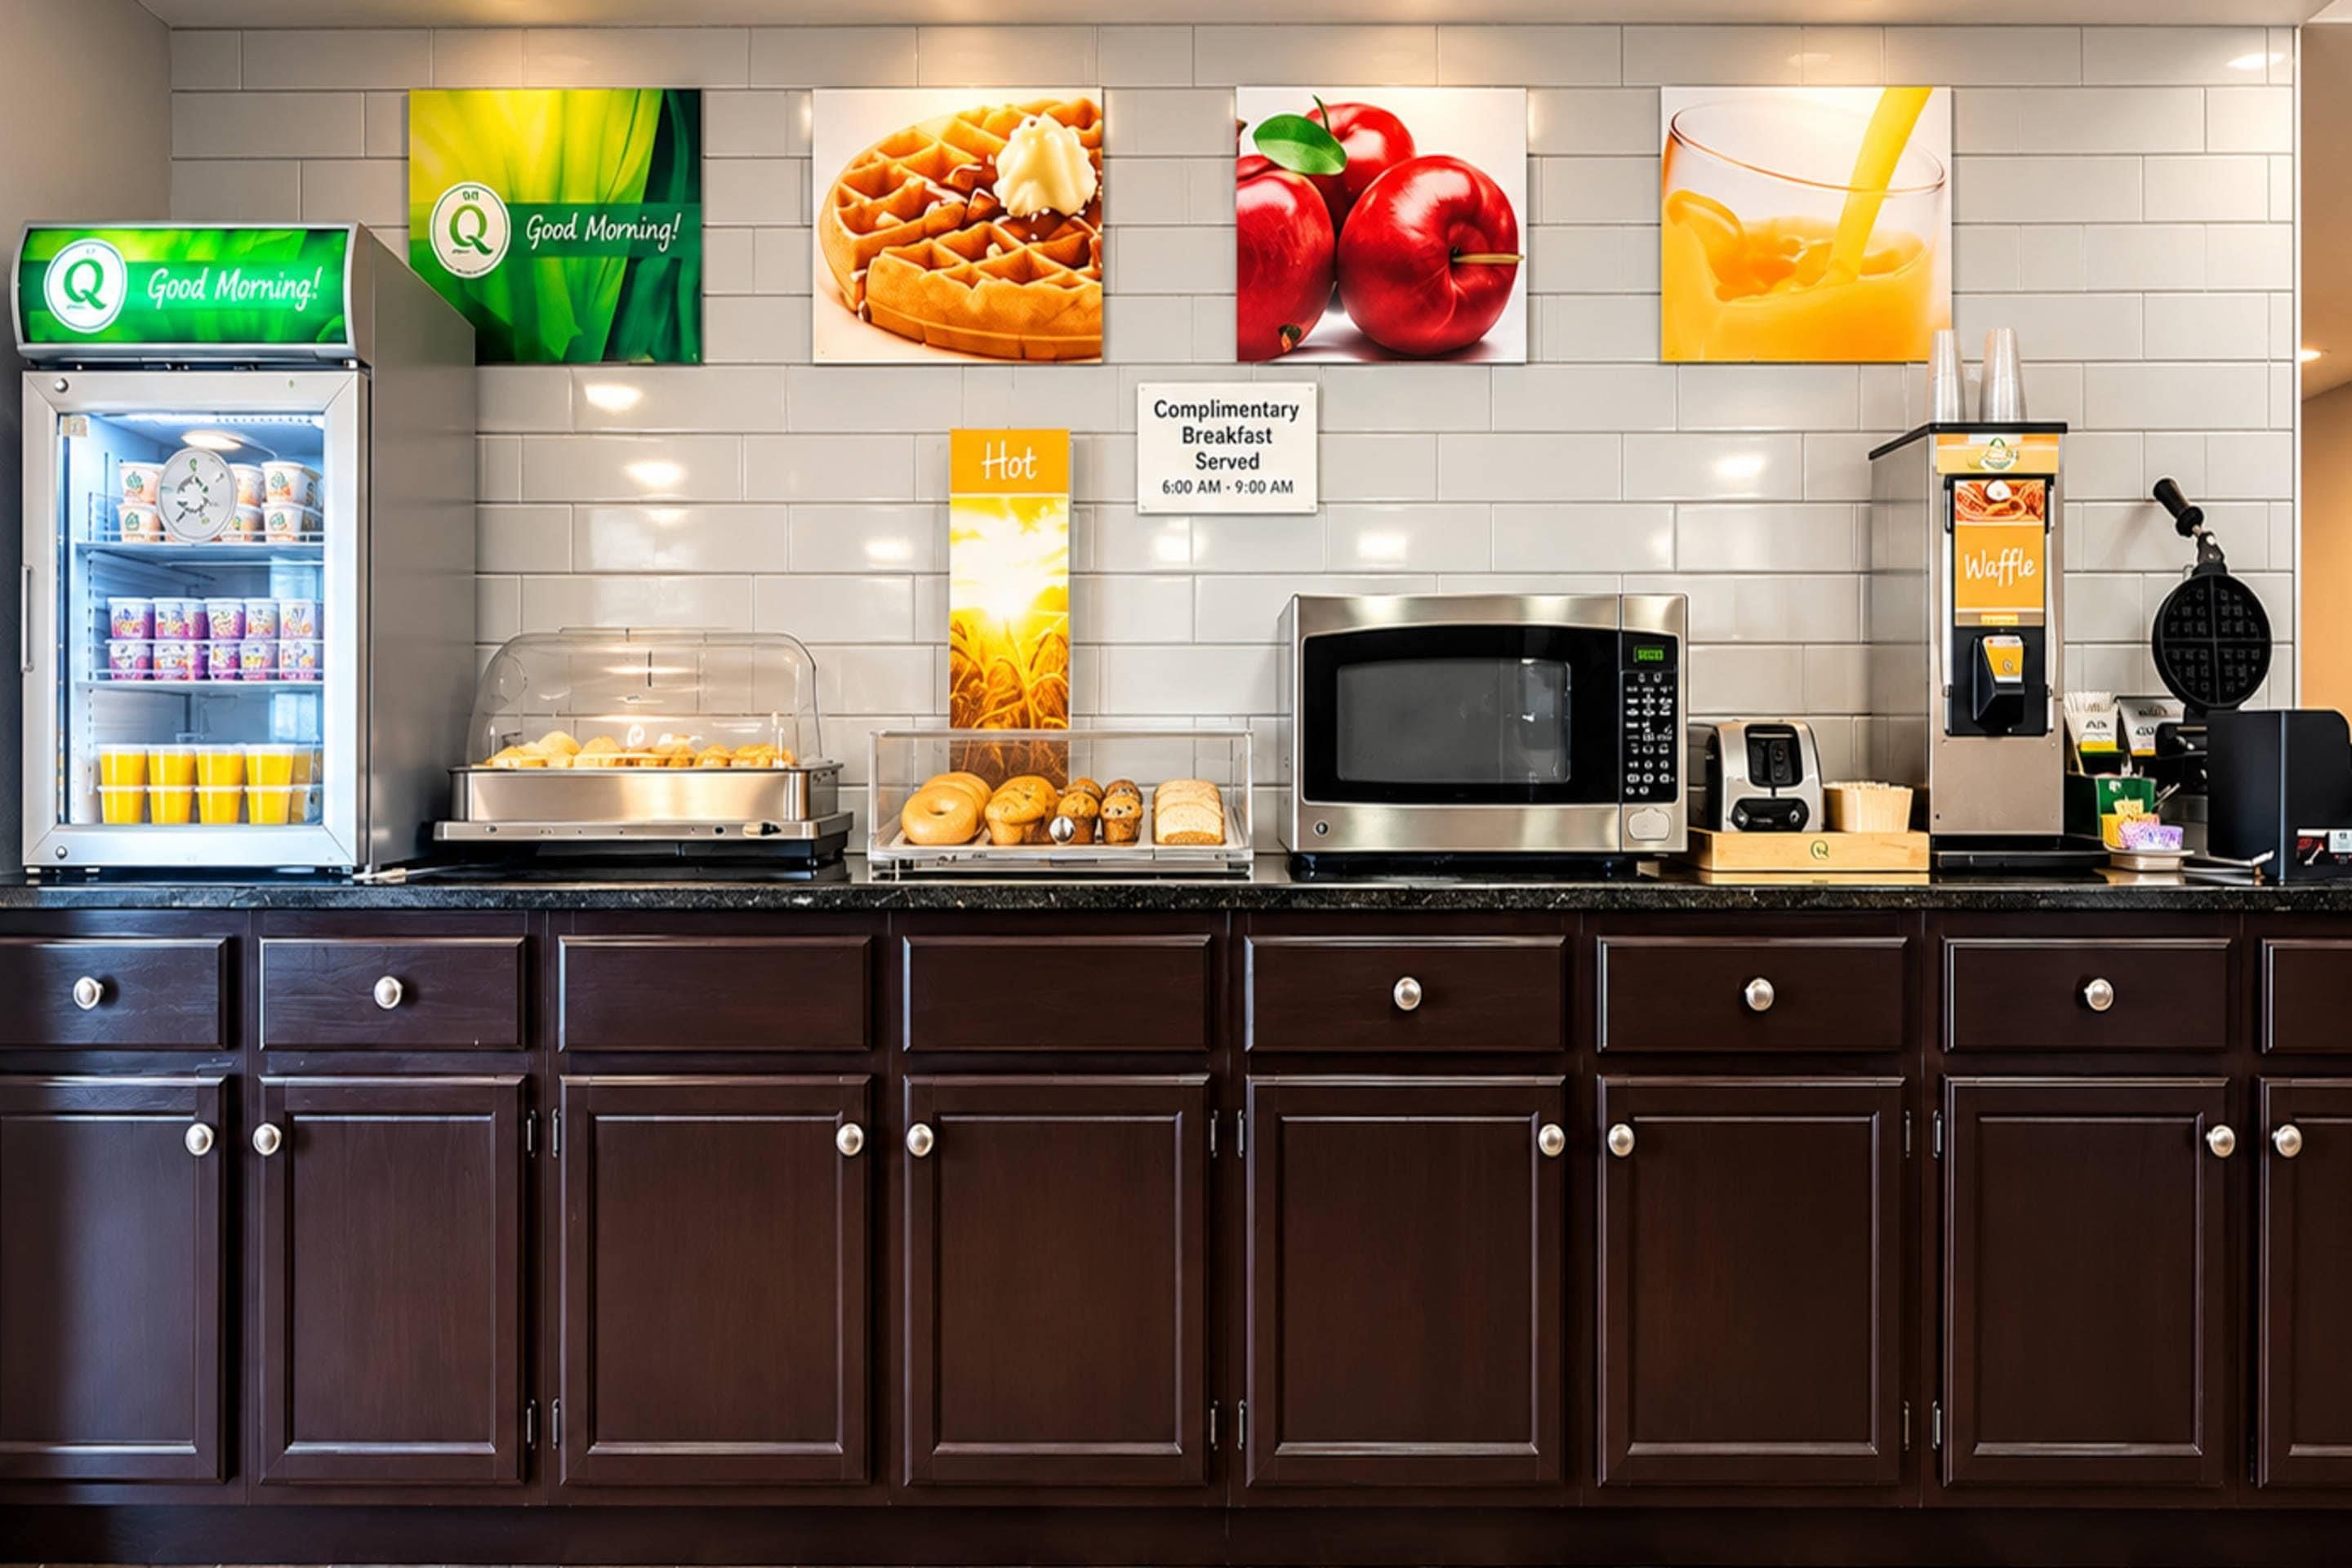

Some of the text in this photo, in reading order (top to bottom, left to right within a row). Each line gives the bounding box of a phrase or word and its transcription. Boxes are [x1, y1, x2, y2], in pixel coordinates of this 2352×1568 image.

[526, 212, 682, 252] Good Morning!
[147, 266, 323, 311] Good Morning!
[1154, 399, 1299, 422] Complimentary
[1182, 425, 1273, 444] Breakfast
[982, 440, 1038, 480] Hot
[1196, 452, 1259, 470] Served
[1162, 479, 1192, 494] 6:00
[1197, 480, 1221, 494] AM
[1235, 479, 1266, 494] 9:00
[1270, 480, 1294, 494] AM
[1964, 548, 2036, 587] Waffle
